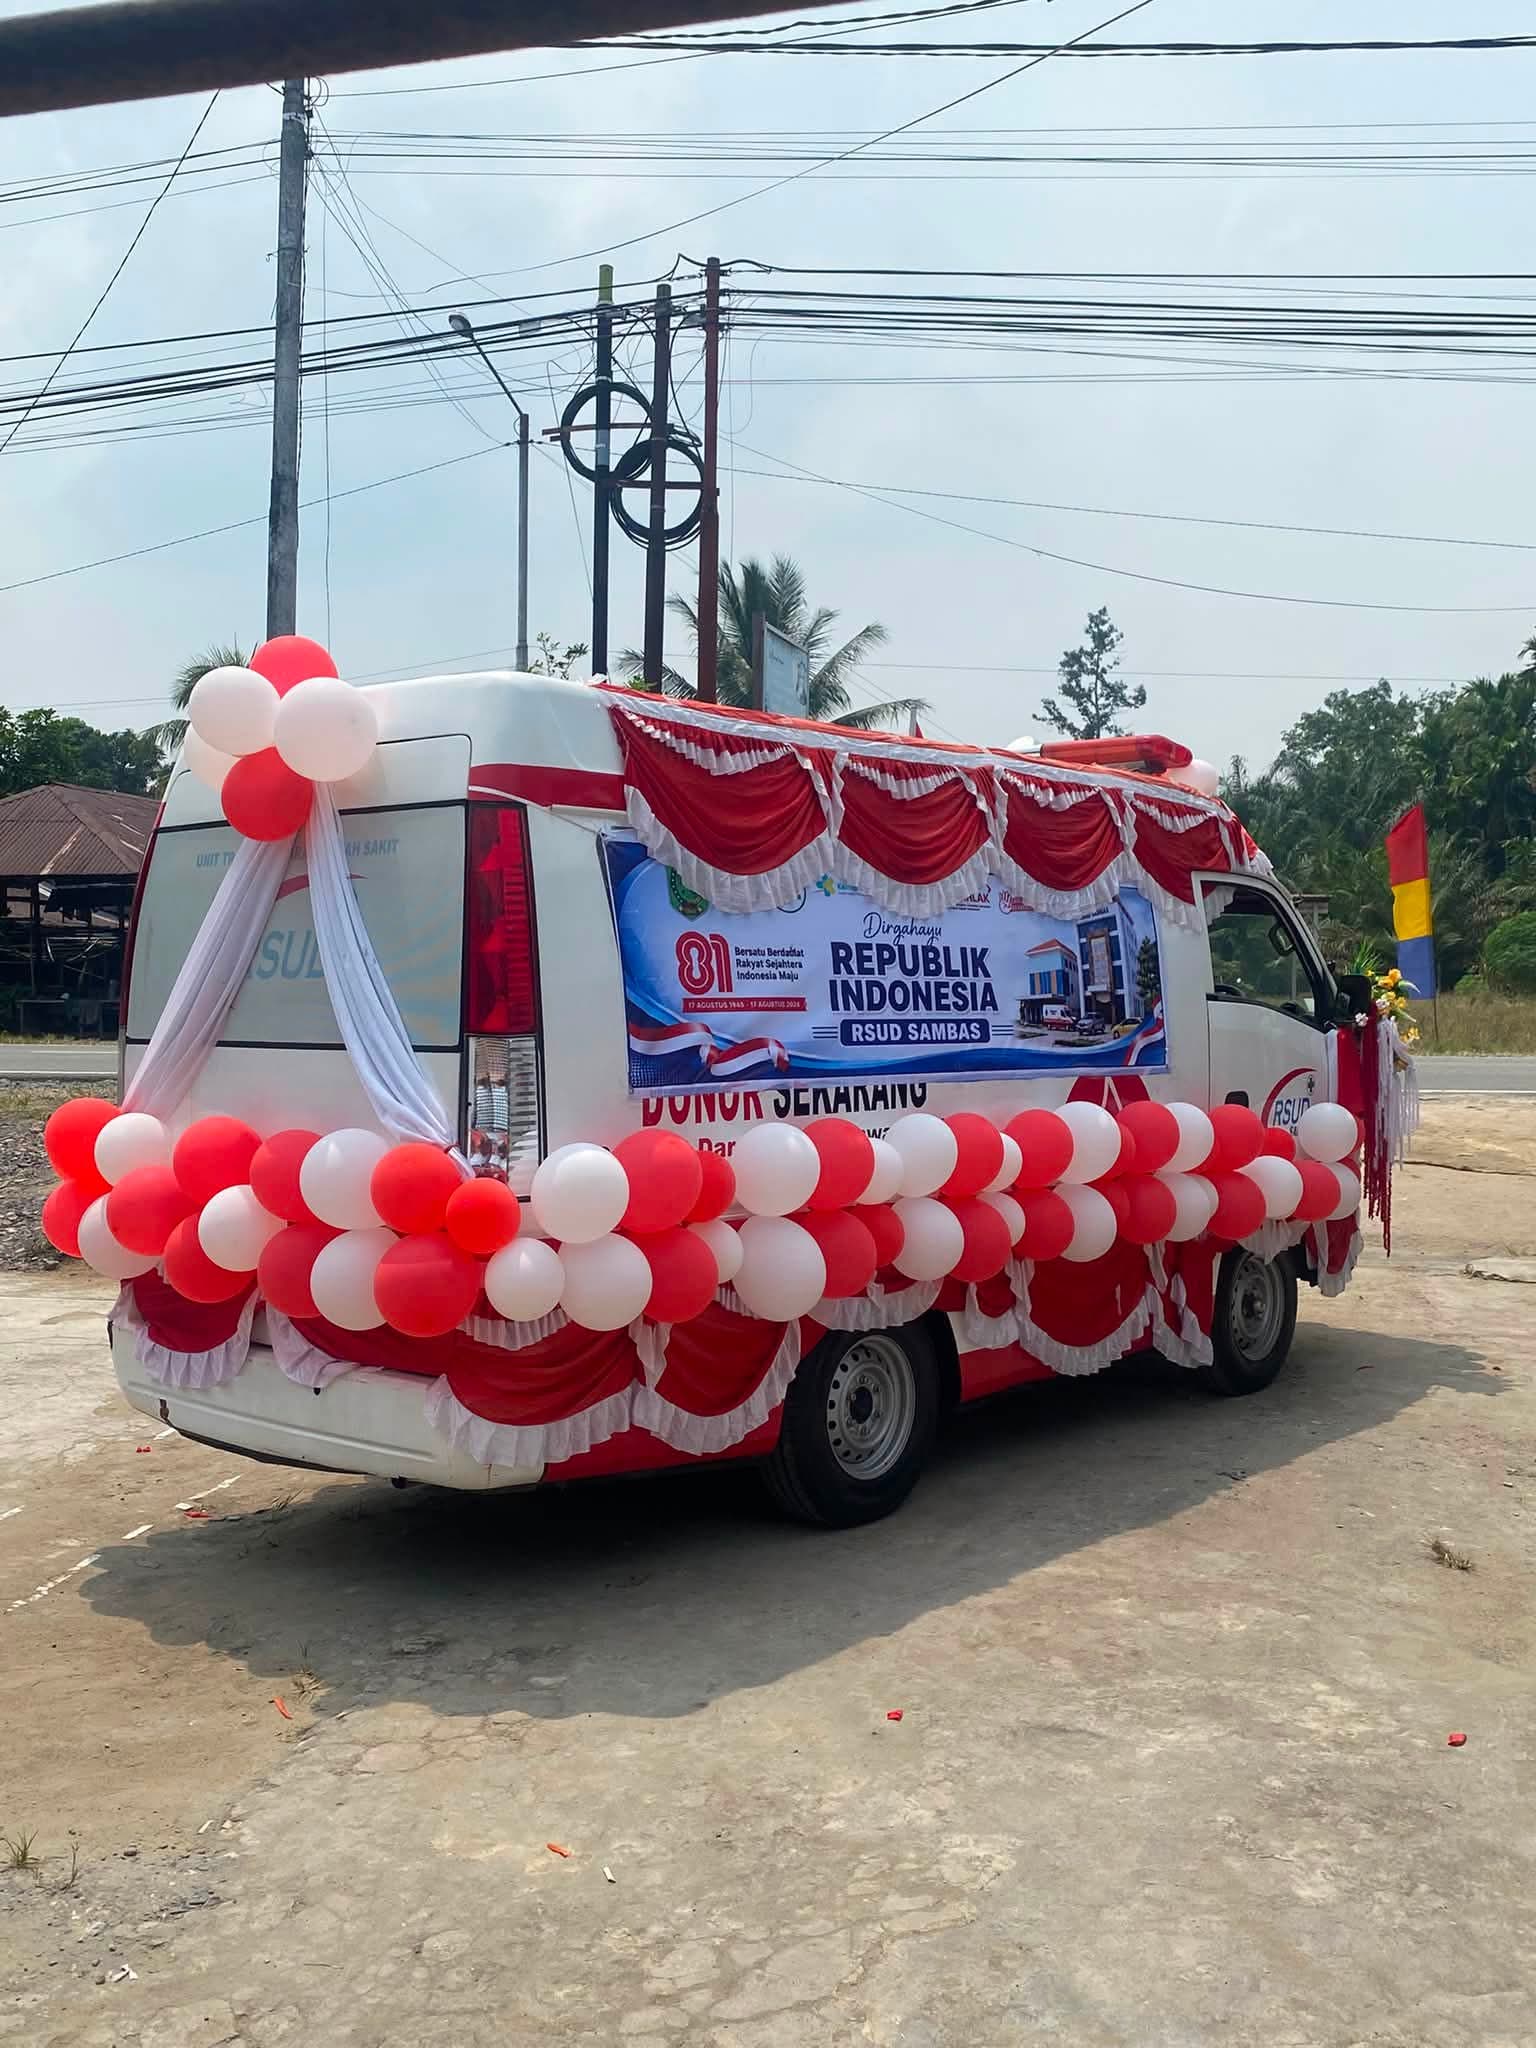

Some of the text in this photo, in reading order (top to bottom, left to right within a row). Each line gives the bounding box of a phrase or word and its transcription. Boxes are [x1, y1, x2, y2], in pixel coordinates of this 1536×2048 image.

[863, 911, 942, 945] Dirgahayu
[675, 931, 733, 995] 81
[734, 946, 766, 957] Bersatu
[736, 959, 803, 970] Rakyat Sejahtera
[830, 941, 992, 978] REPUBLIK
[736, 971, 799, 982] Indonesia Maju
[829, 979, 999, 1012] INDONESIA
[851, 1022, 982, 1042] RSUD SAMBAS
